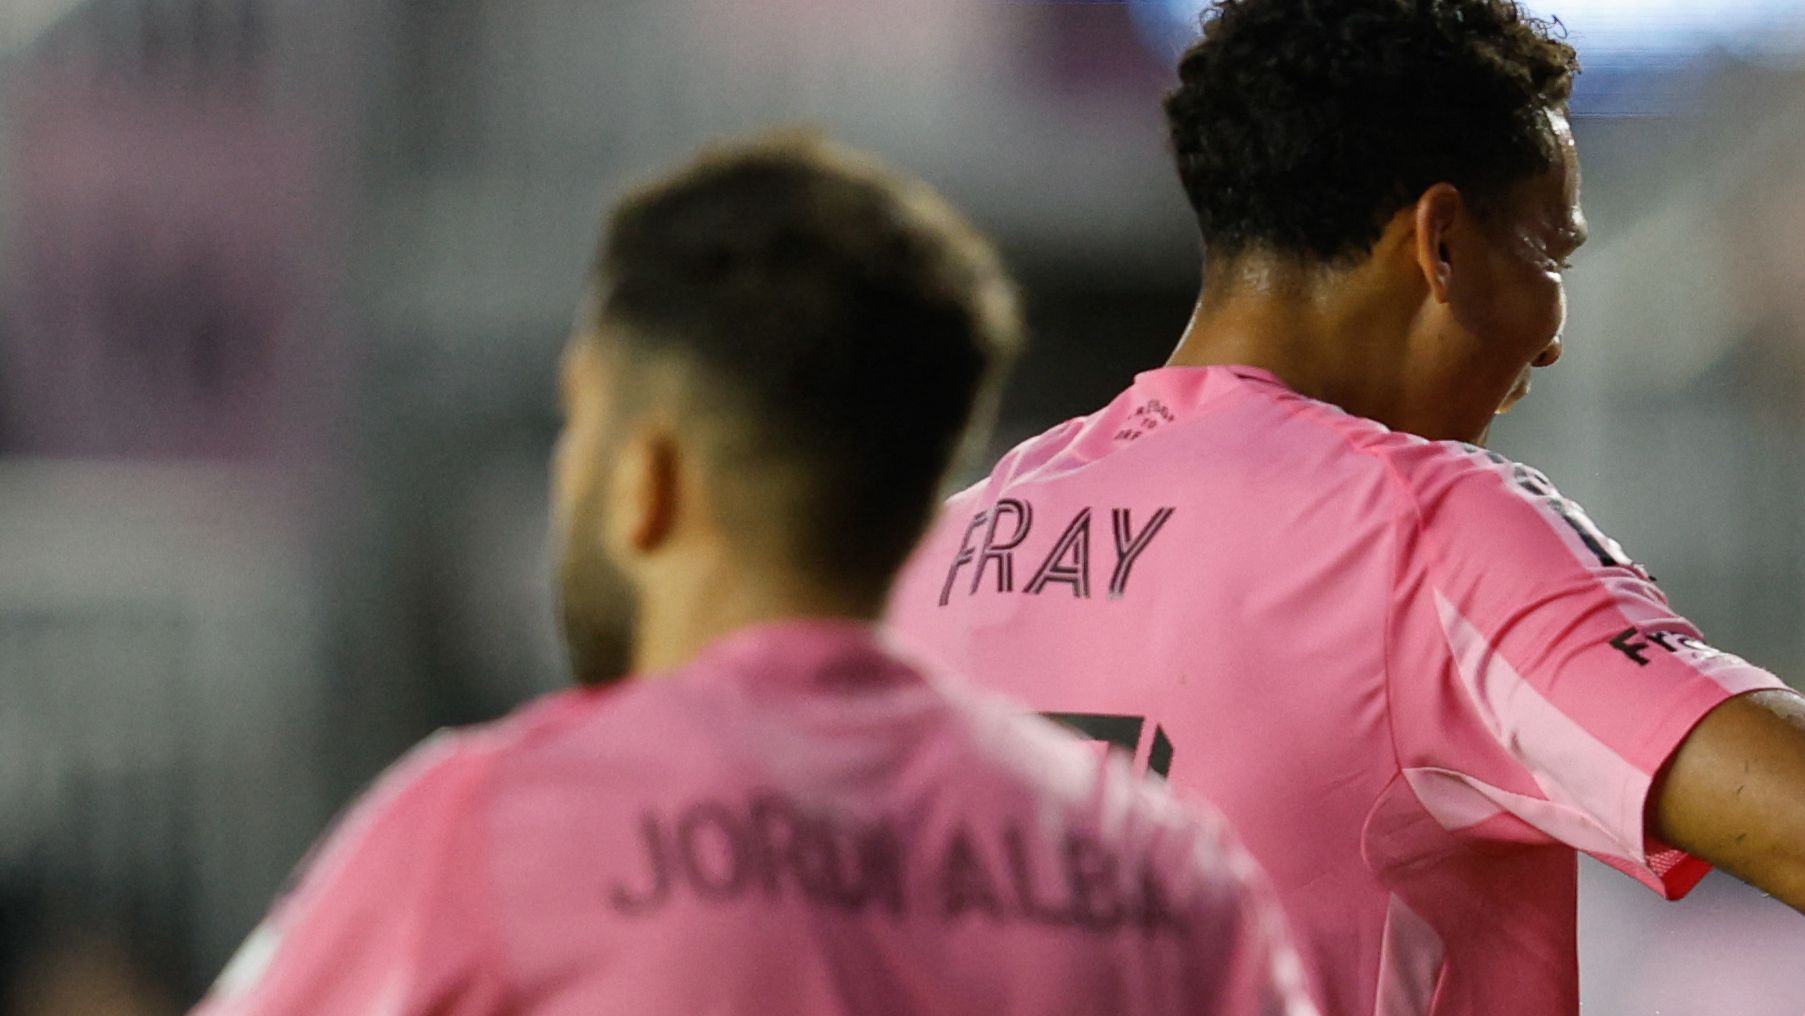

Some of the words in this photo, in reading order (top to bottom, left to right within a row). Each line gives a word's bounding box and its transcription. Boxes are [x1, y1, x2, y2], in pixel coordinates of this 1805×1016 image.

[937, 498, 1177, 606] FRAY
[607, 792, 908, 918] JORDI
[939, 817, 1193, 940] ALBA
